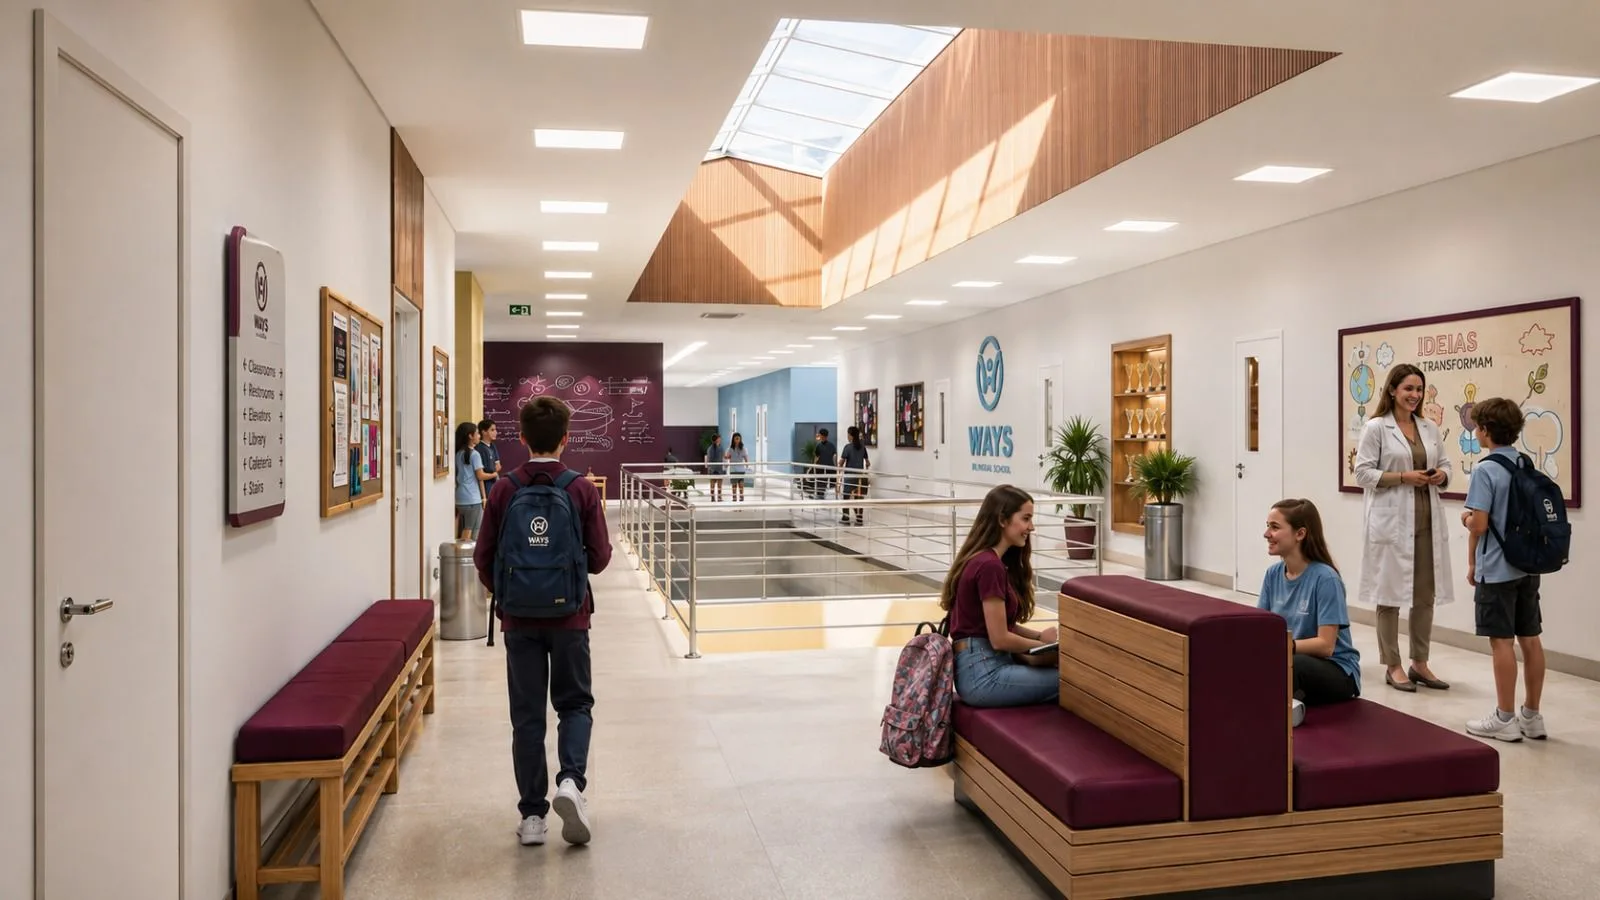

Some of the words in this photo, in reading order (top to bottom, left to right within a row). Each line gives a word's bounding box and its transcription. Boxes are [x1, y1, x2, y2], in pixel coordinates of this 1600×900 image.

[254, 313, 269, 332] WAYS
[1417, 331, 1478, 357] IDEIAS
[248, 359, 276, 378] Classrooms
[1423, 356, 1493, 372] TRANSFORMAM
[248, 383, 275, 400] Restrooms
[248, 407, 272, 422] Elevators
[248, 433, 267, 448] Library
[968, 426, 1014, 457] WAYS
[248, 455, 272, 471] Cafeteria
[248, 480, 264, 495] Stairs
[528, 536, 550, 544] WAYS
